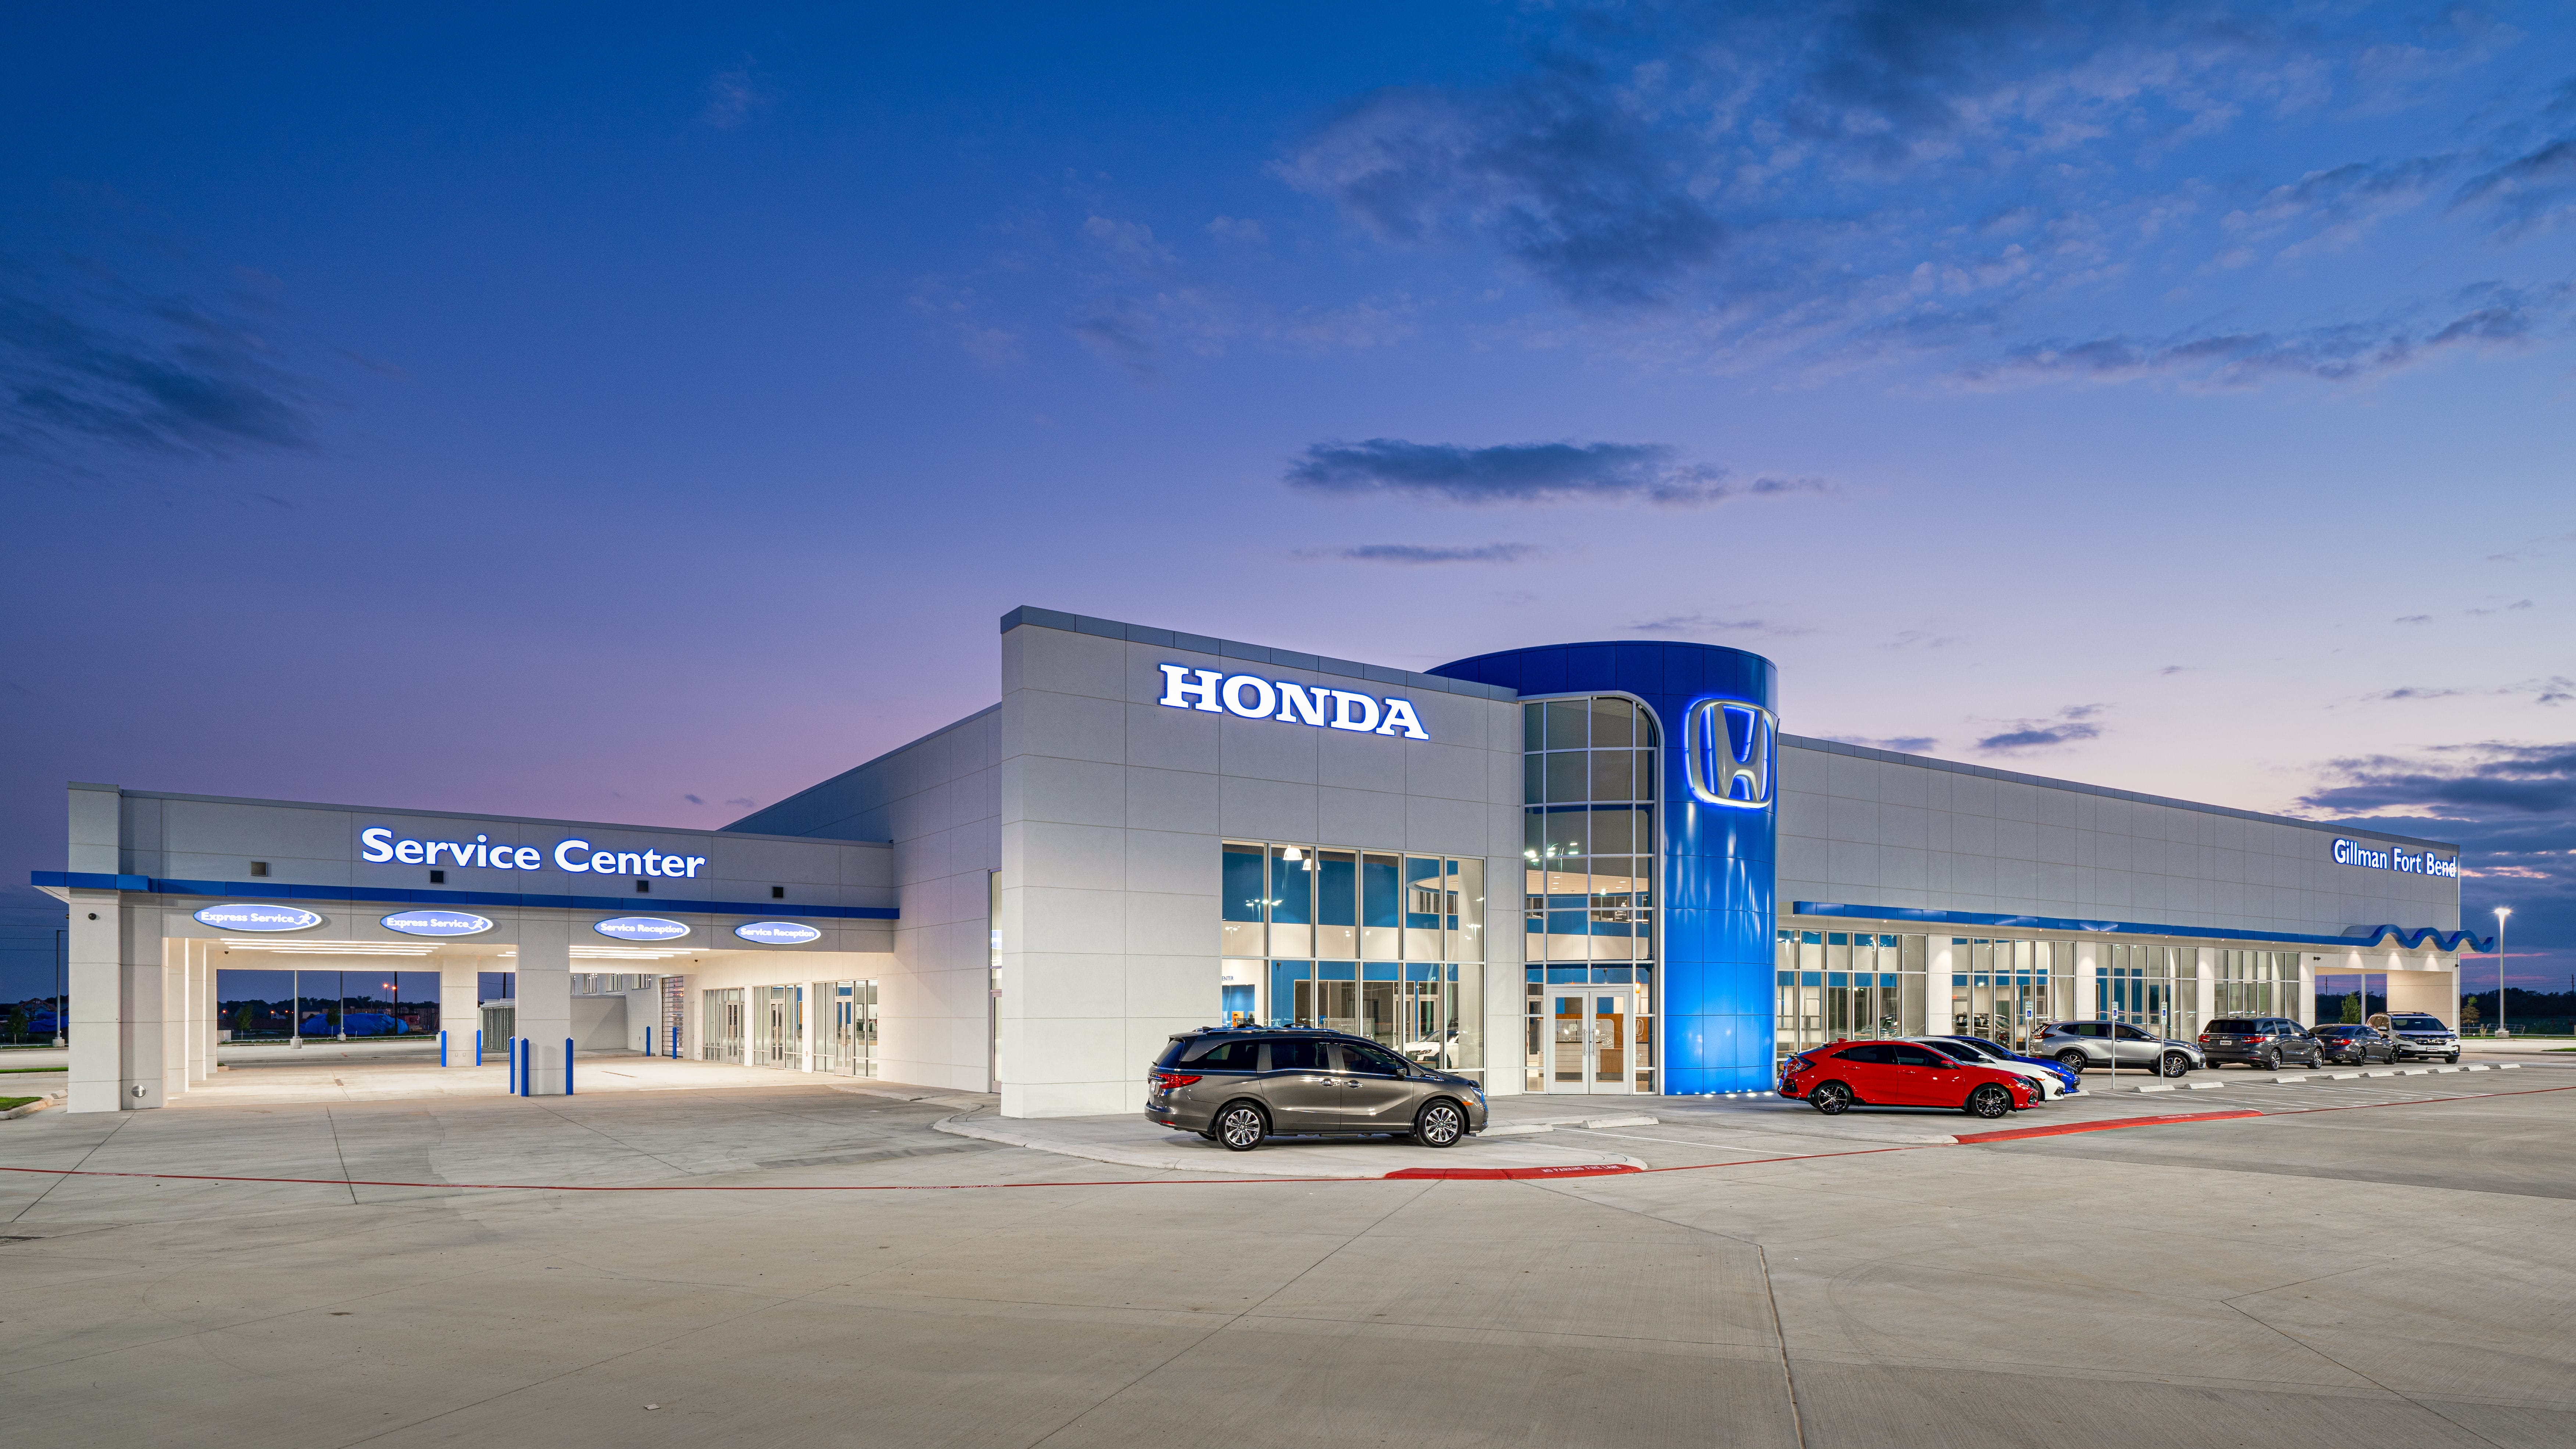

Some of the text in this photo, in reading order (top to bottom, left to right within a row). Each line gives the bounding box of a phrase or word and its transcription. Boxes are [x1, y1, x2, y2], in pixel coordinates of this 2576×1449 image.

[1159, 663, 1430, 740] HONDA
[361, 827, 706, 878] Service Center
[2333, 838, 2457, 878] Gillman Fort Bend
[201, 912, 294, 923] Express Service
[387, 917, 469, 929] Express Service
[601, 923, 683, 935] Service Reception
[740, 927, 815, 938] Service Reception
